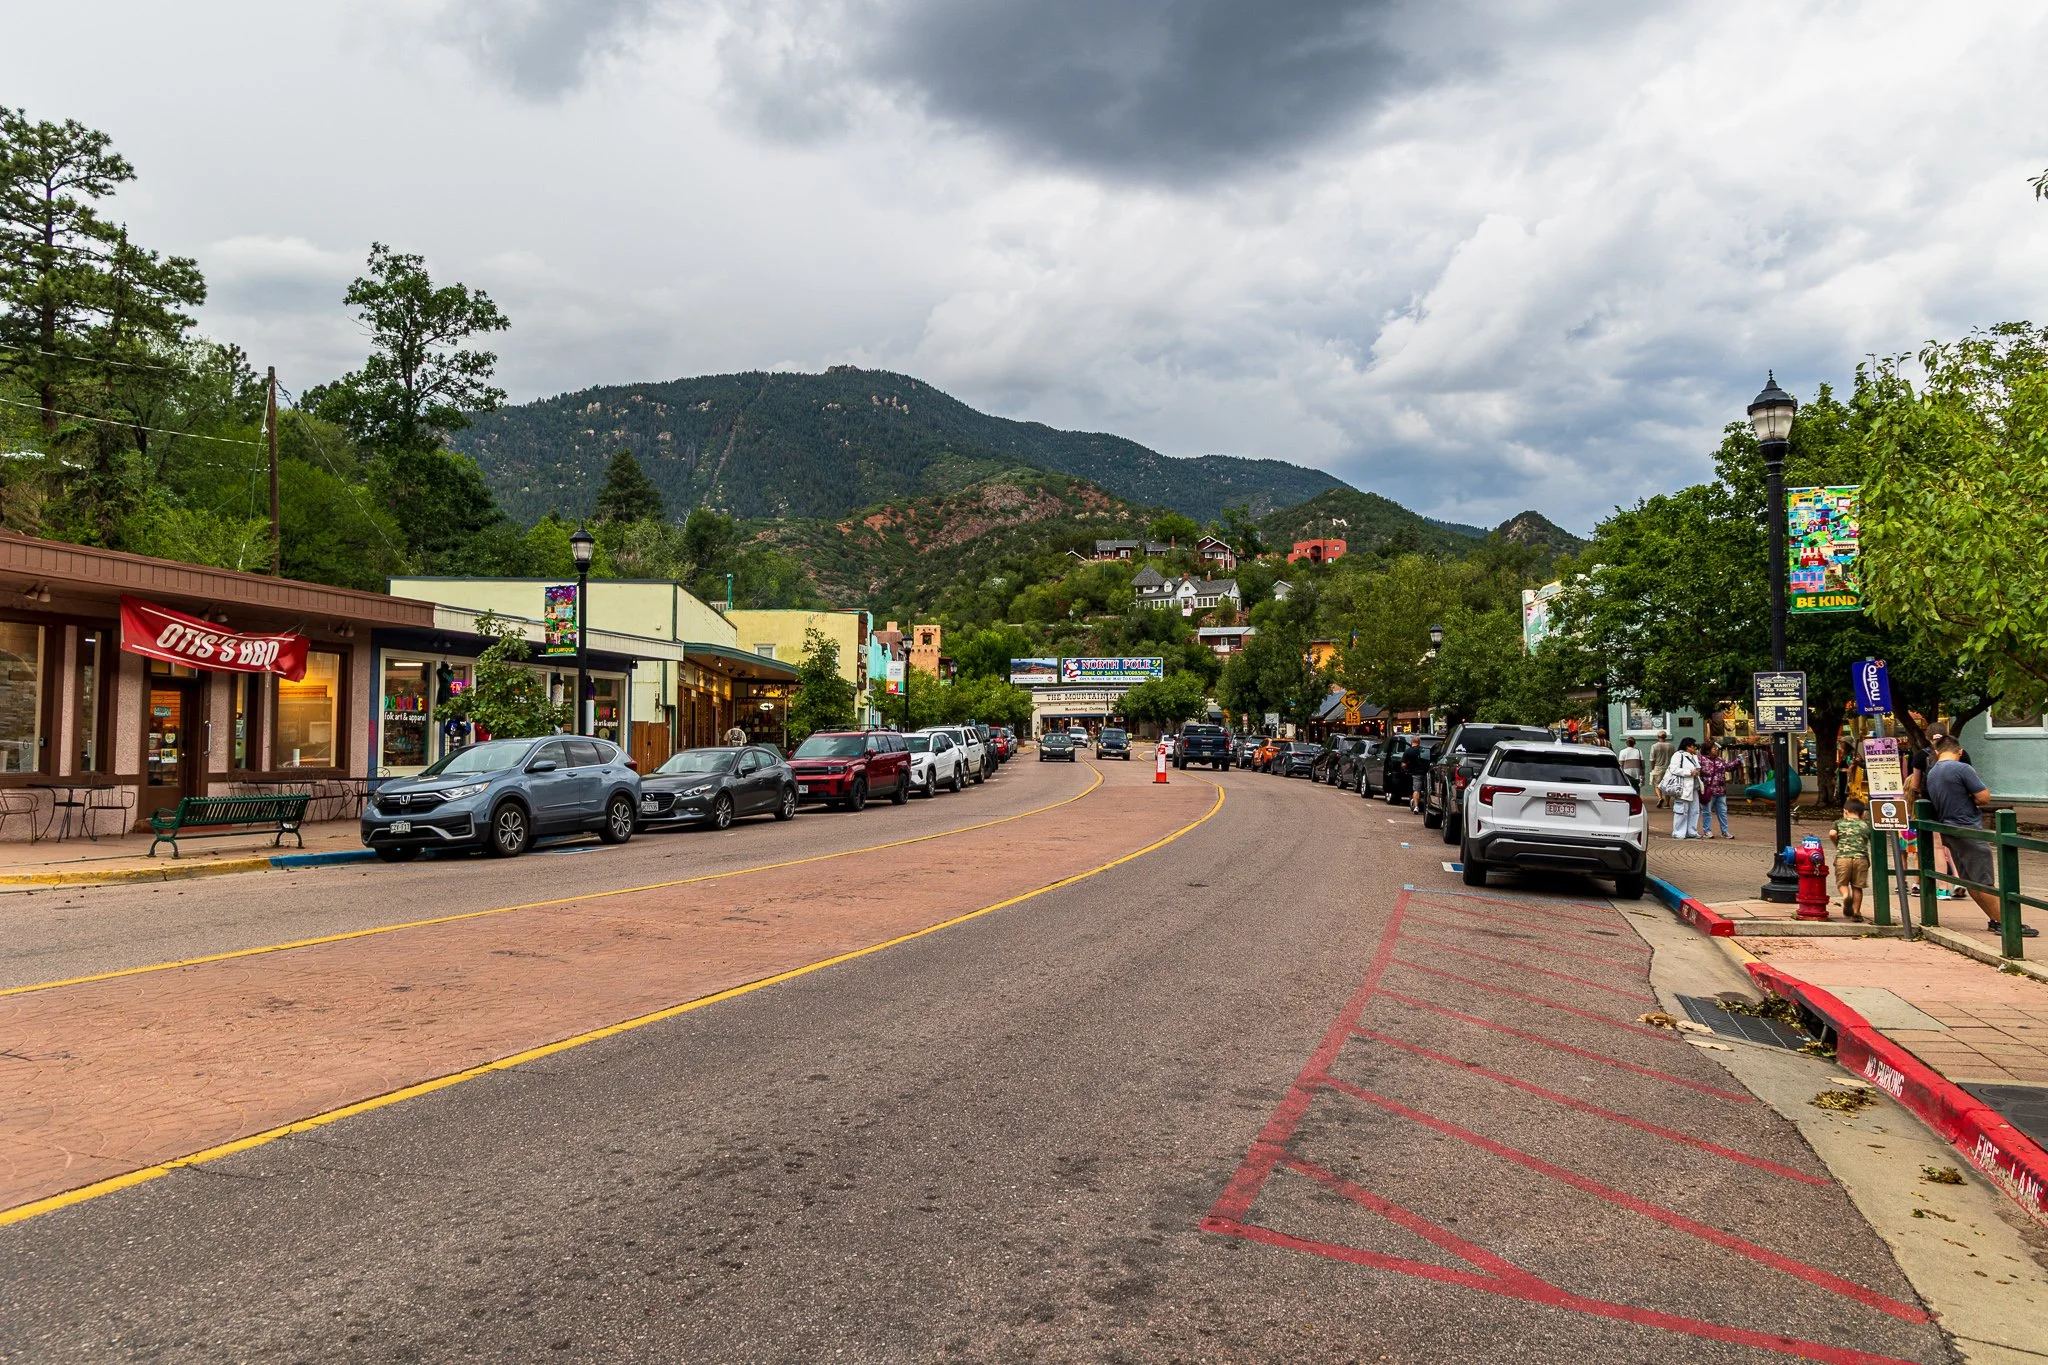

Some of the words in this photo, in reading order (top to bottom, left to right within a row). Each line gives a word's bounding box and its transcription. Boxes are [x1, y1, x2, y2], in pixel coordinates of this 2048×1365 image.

[1796, 597, 1816, 608] BE
[1818, 595, 1858, 607] KIND
[156, 623, 238, 662] OTIS'S
[237, 640, 280, 671] BBQ
[1081, 659, 1119, 670] NORTH
[1122, 659, 1151, 670] POLE
[1874, 660, 1885, 669] 33
[1867, 665, 1881, 701] metro
[384, 711, 394, 721] folk
[394, 713, 403, 721] art
[403, 712, 409, 721] &
[408, 713, 427, 723] apparel
[1349, 712, 1358, 720] 15
[1863, 1054, 1877, 1078] NO
[1873, 1060, 1905, 1098] PARKING
